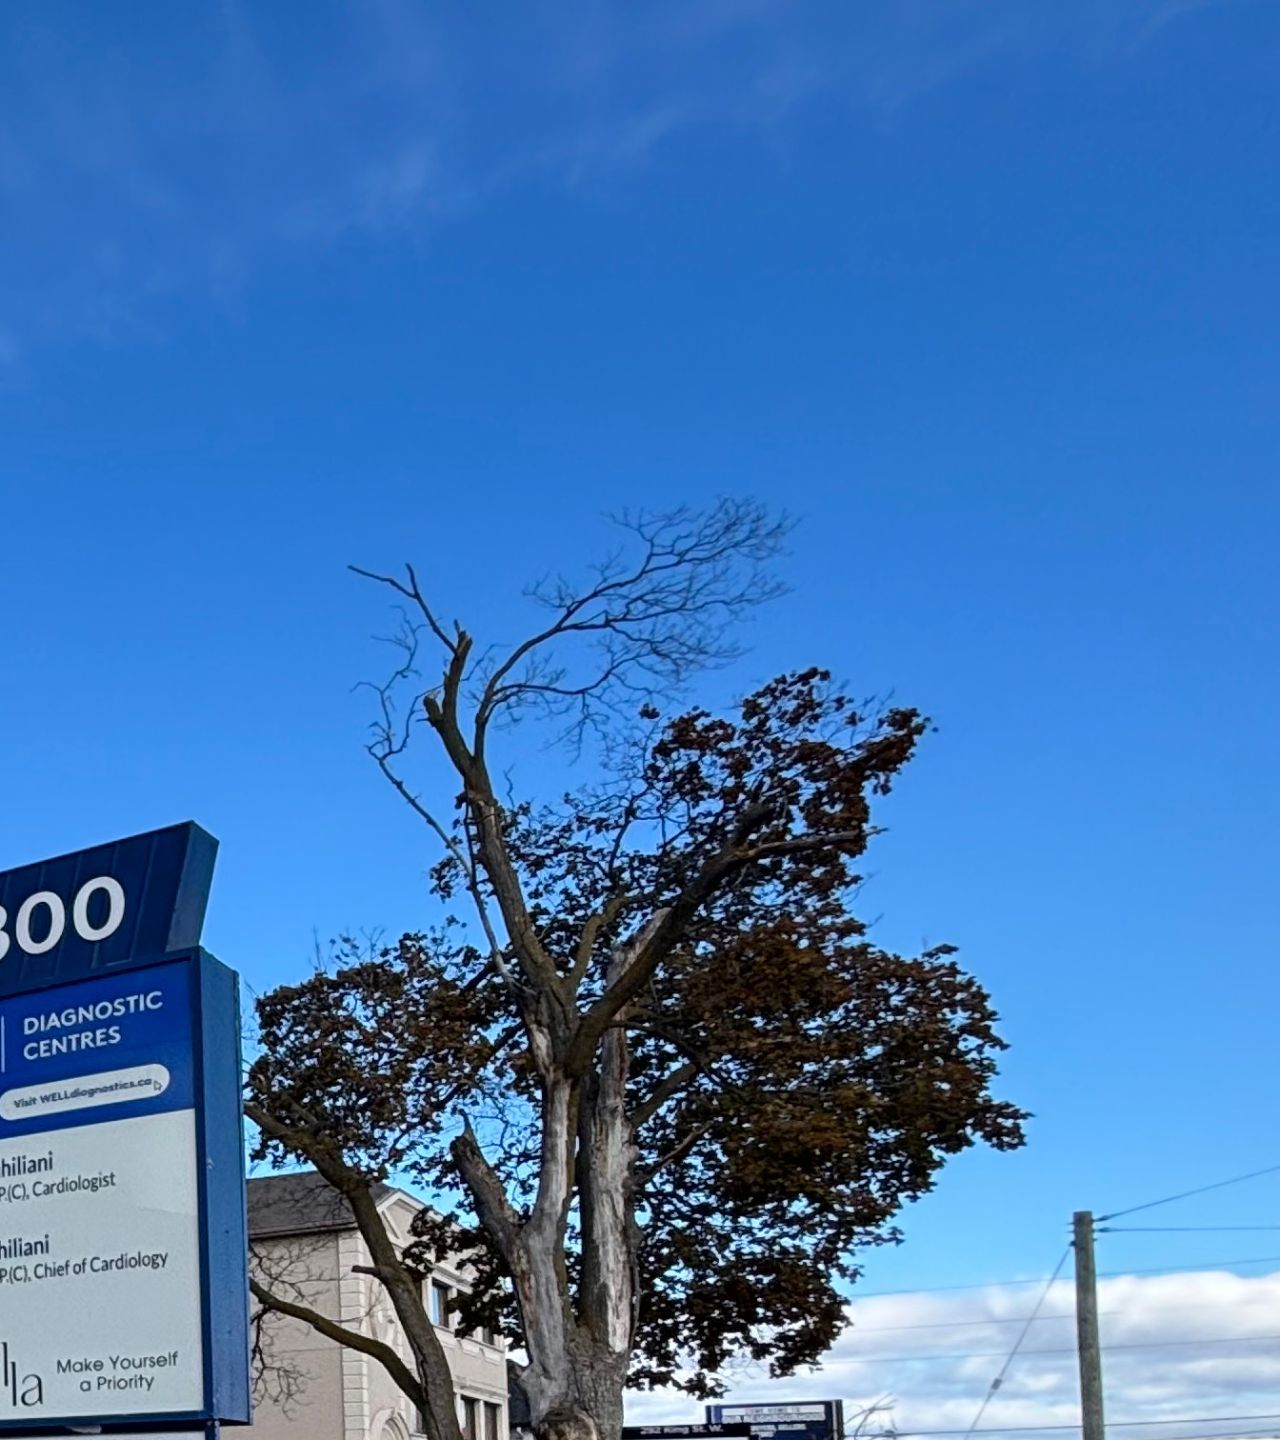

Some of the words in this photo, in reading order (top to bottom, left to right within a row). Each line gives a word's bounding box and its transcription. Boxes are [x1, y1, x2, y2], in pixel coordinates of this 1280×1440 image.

[23, 990, 163, 1036] DIAGNOSTIC
[23, 1025, 121, 1060] CENTRES
[13, 1096, 38, 1109] Visit
[32, 1171, 116, 1198] Cardiologist
[33, 1259, 71, 1280] Chief
[72, 1257, 88, 1275] of
[90, 1250, 169, 1274] Cardiology
[56, 1359, 105, 1374] Make
[109, 1350, 179, 1370] Yourself
[79, 1380, 92, 1392] a
[97, 1374, 155, 1391] Priority
